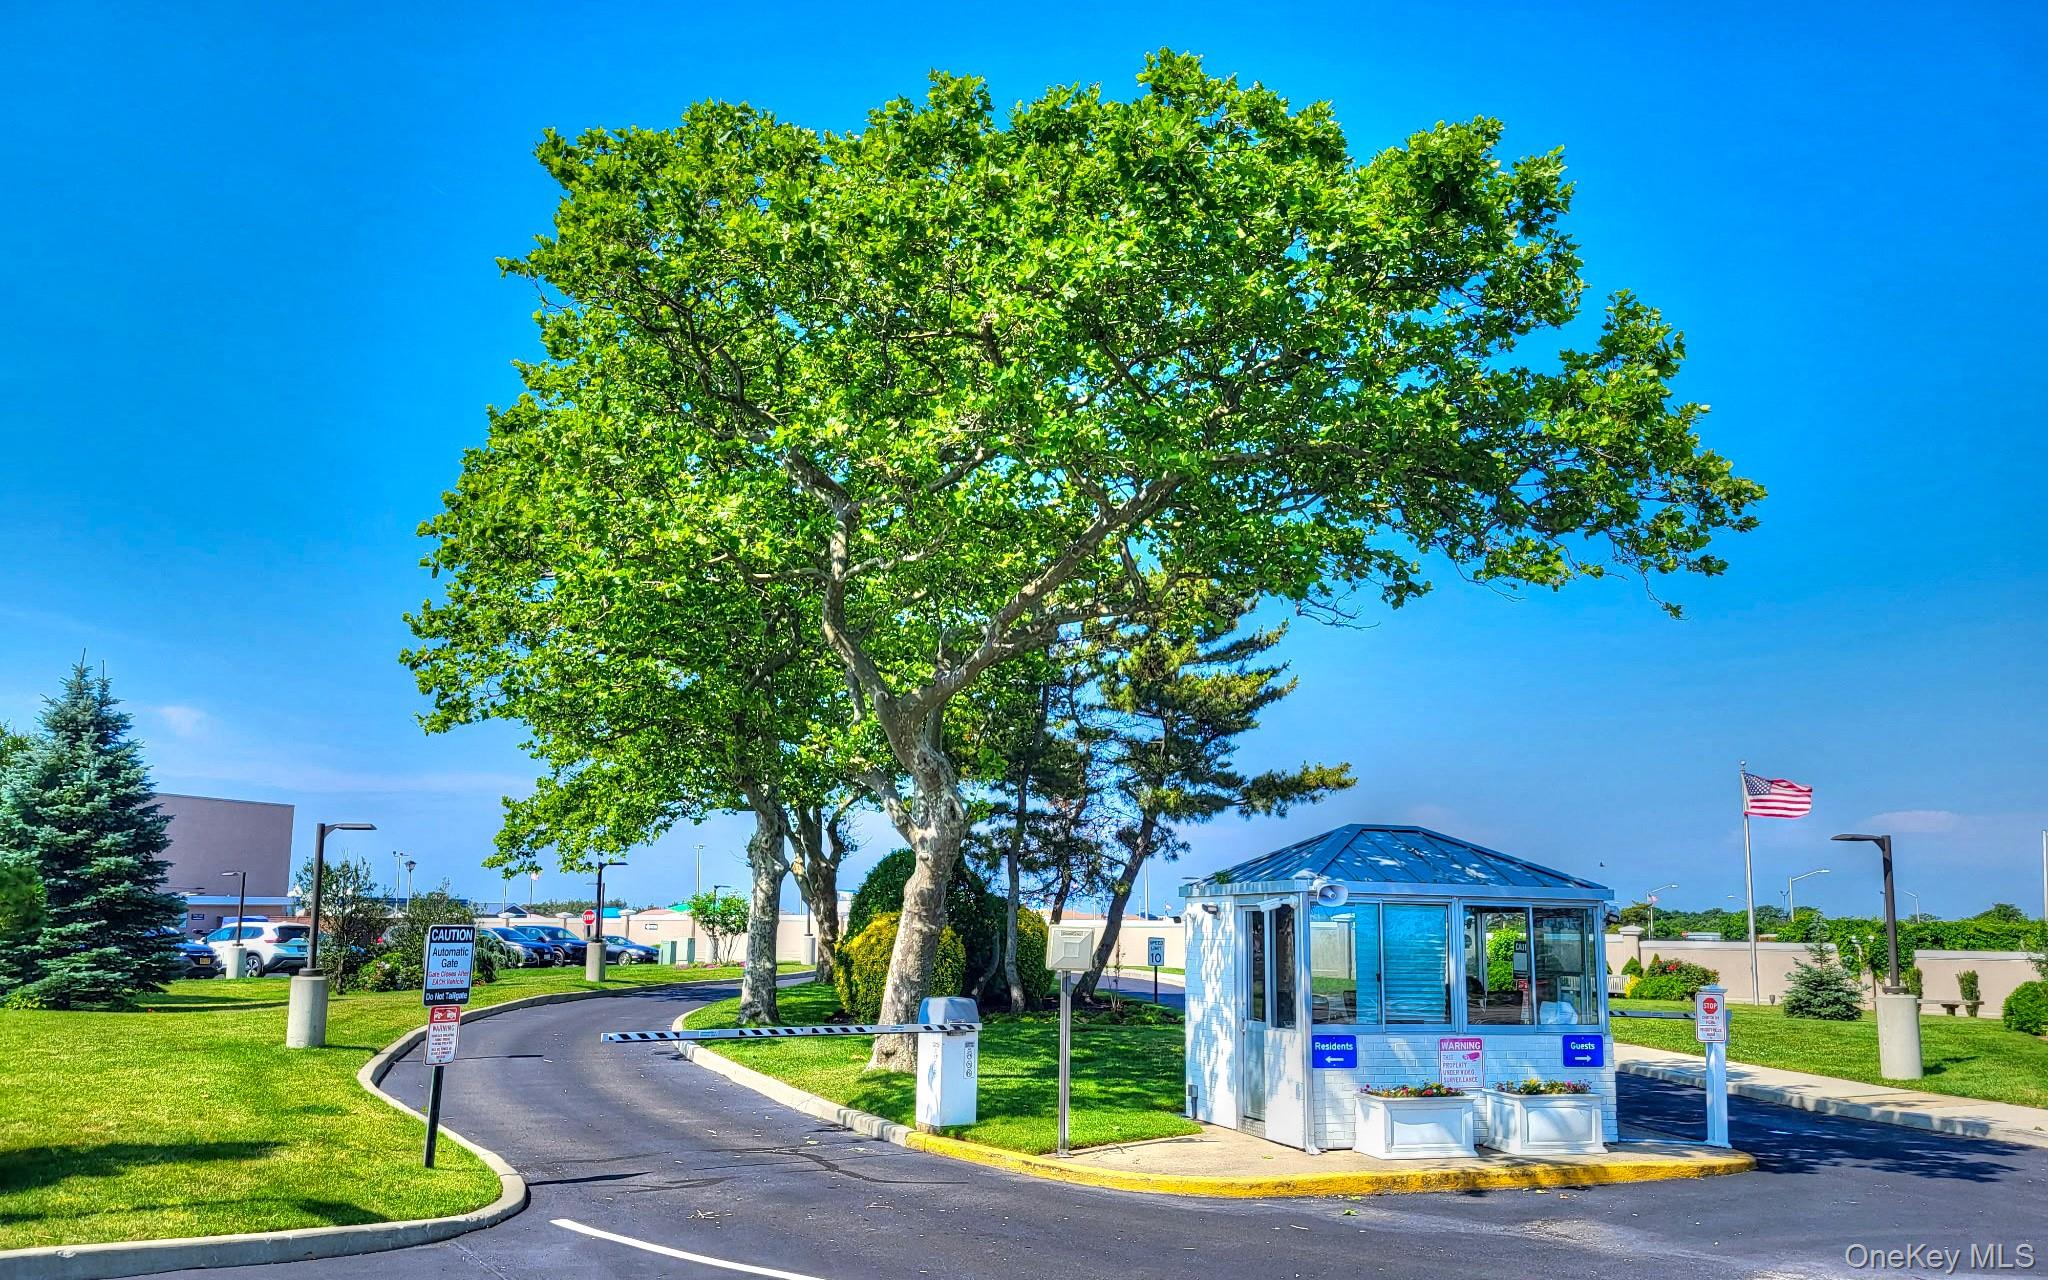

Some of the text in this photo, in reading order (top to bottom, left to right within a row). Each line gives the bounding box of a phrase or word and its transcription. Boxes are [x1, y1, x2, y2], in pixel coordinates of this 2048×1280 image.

[431, 929, 473, 941] CAUTION
[432, 946, 469, 957] Automatic
[441, 958, 459, 968] Gate
[1151, 953, 1161, 963] 10
[425, 991, 468, 1002] Do Not Tailgate
[1314, 1041, 1354, 1051] Residents
[1441, 1041, 1481, 1050] WARNING
[1570, 1041, 1596, 1050] Guests
